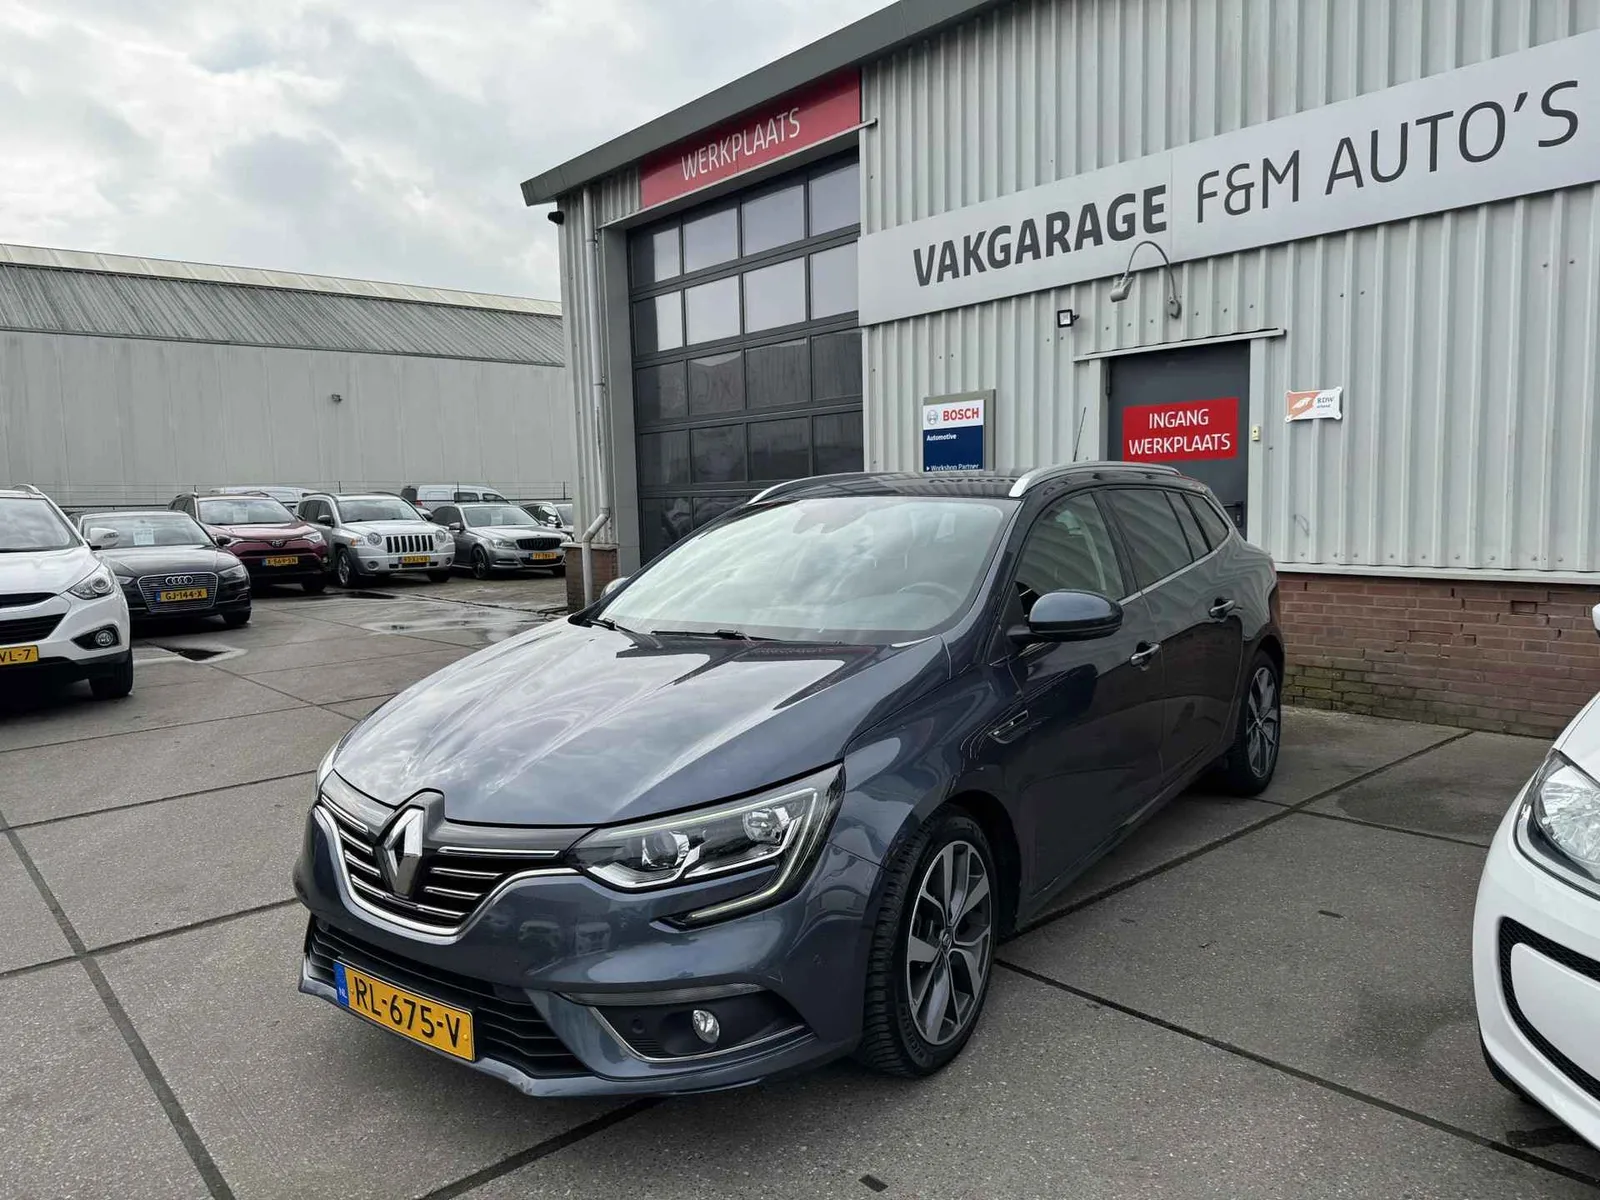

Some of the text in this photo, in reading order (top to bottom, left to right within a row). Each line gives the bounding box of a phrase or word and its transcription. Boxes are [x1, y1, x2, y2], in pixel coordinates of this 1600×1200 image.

[681, 107, 800, 181] WERKPLAATS
[913, 80, 1579, 287] VAKGARAGE F&M AUTO'S
[942, 407, 980, 421] BOSCH
[1149, 408, 1209, 429] INGANG
[926, 433, 957, 441] Automotive
[1128, 433, 1231, 455] WERKPLAATS
[958, 463, 979, 471] Partner
[165, 590, 203, 600] GJ-144-X
[354, 976, 461, 1048] RL-675-V
